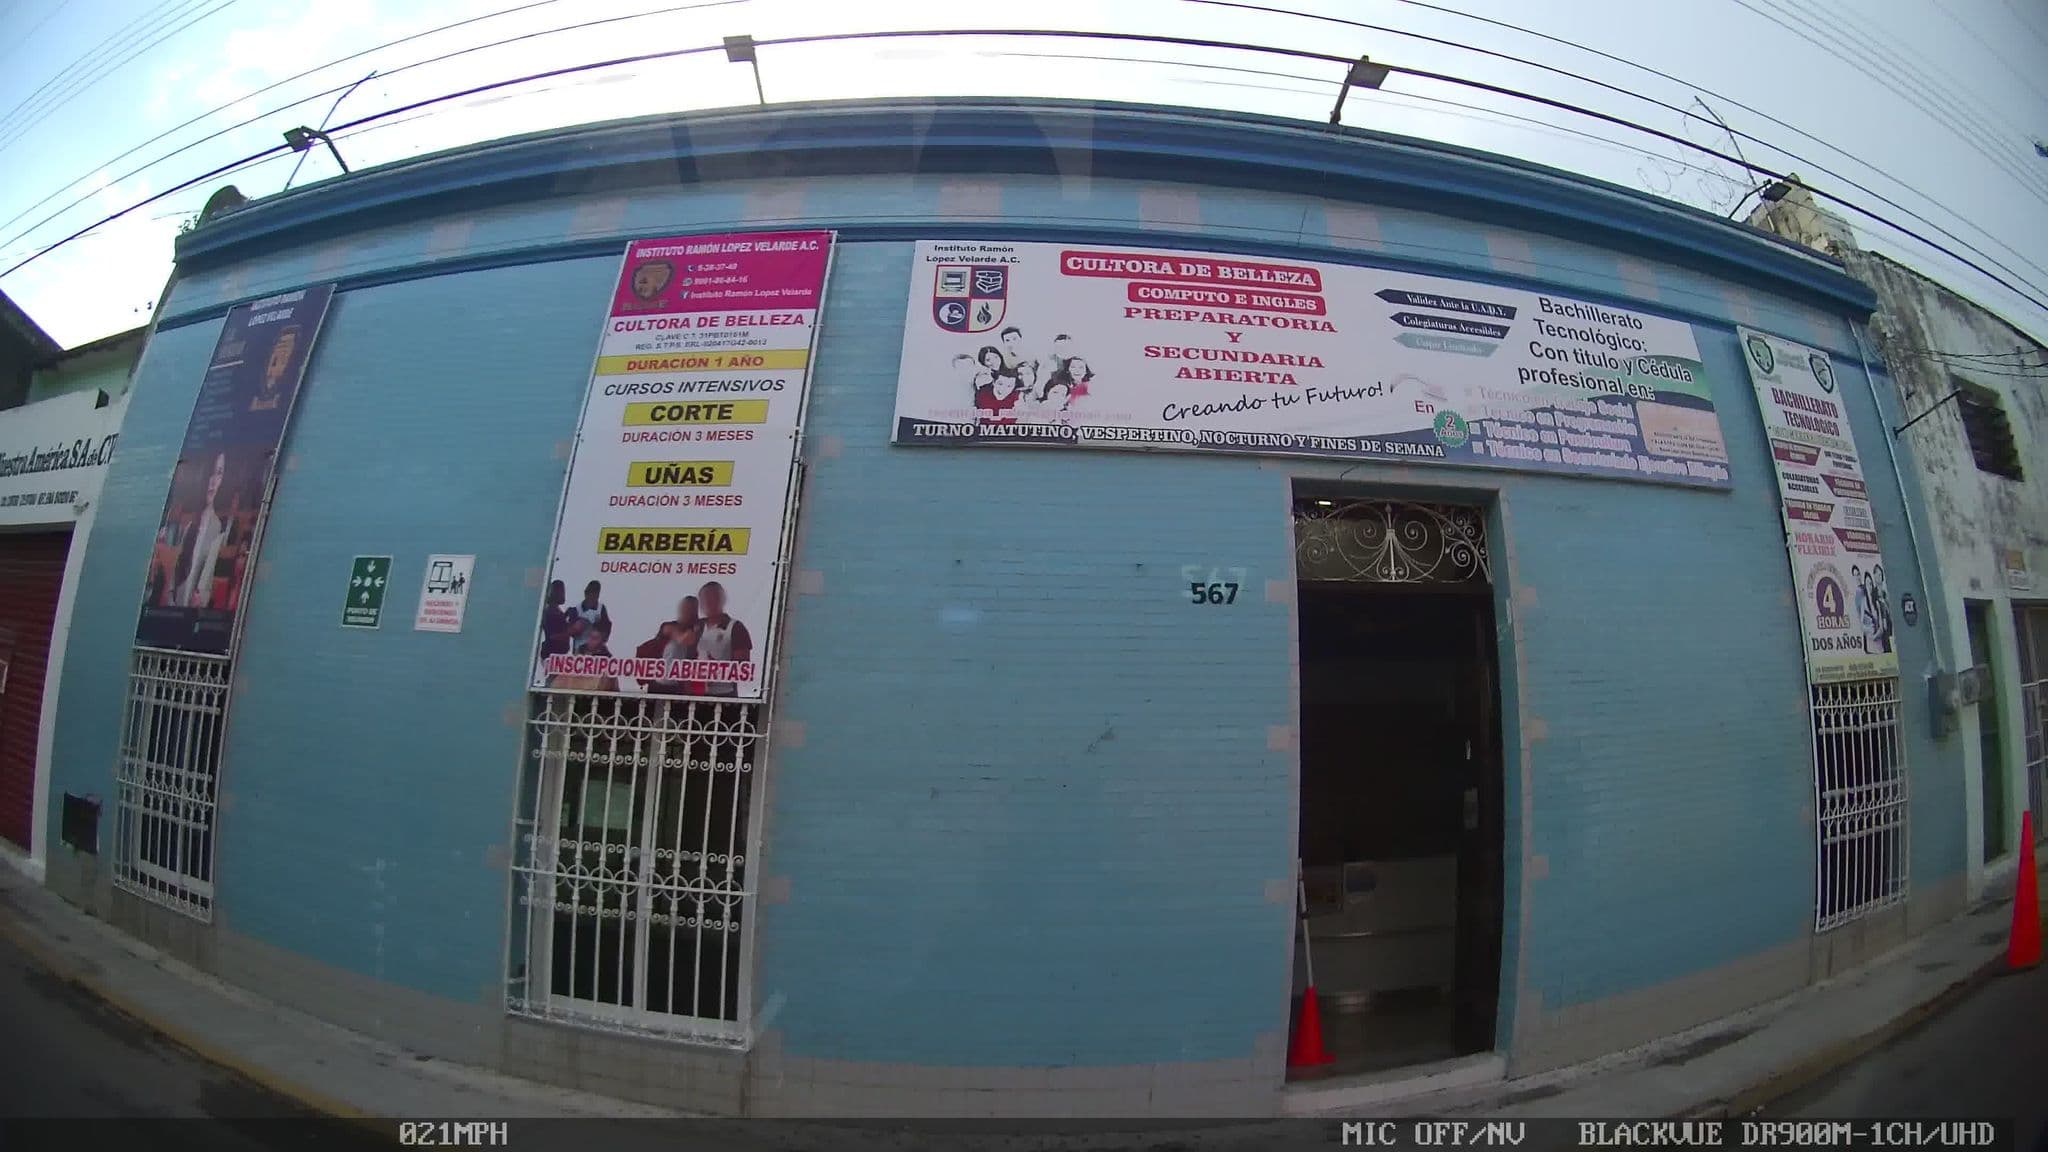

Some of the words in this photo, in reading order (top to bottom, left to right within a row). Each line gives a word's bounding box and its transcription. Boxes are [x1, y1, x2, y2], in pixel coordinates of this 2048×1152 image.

[636, 246, 684, 258] INSTITUTO
[686, 242, 721, 254] RAMÓN
[721, 242, 752, 253] LOPEZ
[754, 240, 798, 252] VELARDE
[798, 240, 820, 250] A.C.
[934, 244, 977, 253] Instituto
[979, 244, 1014, 253] Ramón
[926, 256, 956, 264] Lopez
[958, 255, 997, 263] Velarde
[1000, 256, 1021, 264] A.C.
[1066, 256, 1175, 276] CULTORA
[1179, 263, 1212, 278] DE
[1216, 264, 1316, 287] BELLEZA
[690, 290, 723, 299] Instituto
[754, 290, 779, 299] Lopez
[782, 288, 812, 296] Velarde
[1138, 286, 1230, 304] COMPUTO
[1234, 294, 1248, 305] E
[1251, 295, 1318, 311] INGLES
[1406, 293, 1438, 306] Validez
[1439, 298, 1460, 309] Ante
[1461, 301, 1470, 311] la
[1472, 302, 1507, 317] U.A.D.Y.
[1538, 296, 1643, 330] Bachillerato
[614, 318, 693, 332] CULTORA
[697, 316, 720, 328] DE
[725, 314, 805, 327] BELLEZA
[1122, 306, 1338, 333] PREPARATORIA
[1402, 316, 1457, 331] Colegiaturas
[1459, 323, 1502, 337] Accesibles
[1224, 331, 1244, 344] Y
[1532, 318, 1648, 352] Tecnológico:
[627, 354, 709, 371] DURACIÓN
[714, 356, 723, 368] 1
[727, 354, 764, 367] AÑO
[1143, 346, 1326, 368] SECUNDARIA
[1528, 341, 1569, 362] Con
[1572, 350, 1620, 370] titulo
[1623, 358, 1634, 377] y
[1638, 358, 1693, 383] Cédula
[1174, 366, 1298, 386] ABIERTA
[1518, 366, 1624, 394] profesional
[1628, 382, 1656, 400] en:
[604, 381, 675, 396] CURSOS
[678, 379, 786, 394] INTENSIVOS
[1162, 394, 1267, 422] Creando
[1271, 392, 1300, 410] tu
[1305, 381, 1384, 406] Futuro!
[1414, 400, 1435, 414] En
[1771, 388, 1840, 419] BACHILLERATO
[650, 403, 735, 423] CORTE
[1446, 416, 1455, 428] 2
[1782, 410, 1841, 436] TECNOLOGICO
[695, 432, 702, 442] 3
[706, 430, 754, 442] MESES
[913, 423, 975, 437] TURNO
[978, 424, 1077, 440] MATUTINO,
[1082, 426, 1200, 446] VESPERTINO,
[1200, 430, 1293, 448] NOCTURNO
[1293, 435, 1308, 448] Y
[1310, 438, 1357, 452] FINES
[1360, 440, 1382, 454] DE
[1384, 440, 1446, 458] SEMANA
[644, 463, 715, 485] UÑAS
[682, 496, 690, 506] 3
[694, 494, 744, 506] MESES
[604, 528, 734, 553] BARBERÍA
[676, 562, 684, 574] 3
[687, 562, 738, 575] MESES
[1191, 582, 1239, 605] 567
[1823, 583, 1836, 613] 4
[1818, 615, 1850, 630] HORAS
[1812, 636, 1834, 651] DOS
[1836, 632, 1863, 651] AÑOS
[544, 656, 666, 680] ¡INSCRIPCIONES
[668, 660, 756, 683] ABIERTAS!
